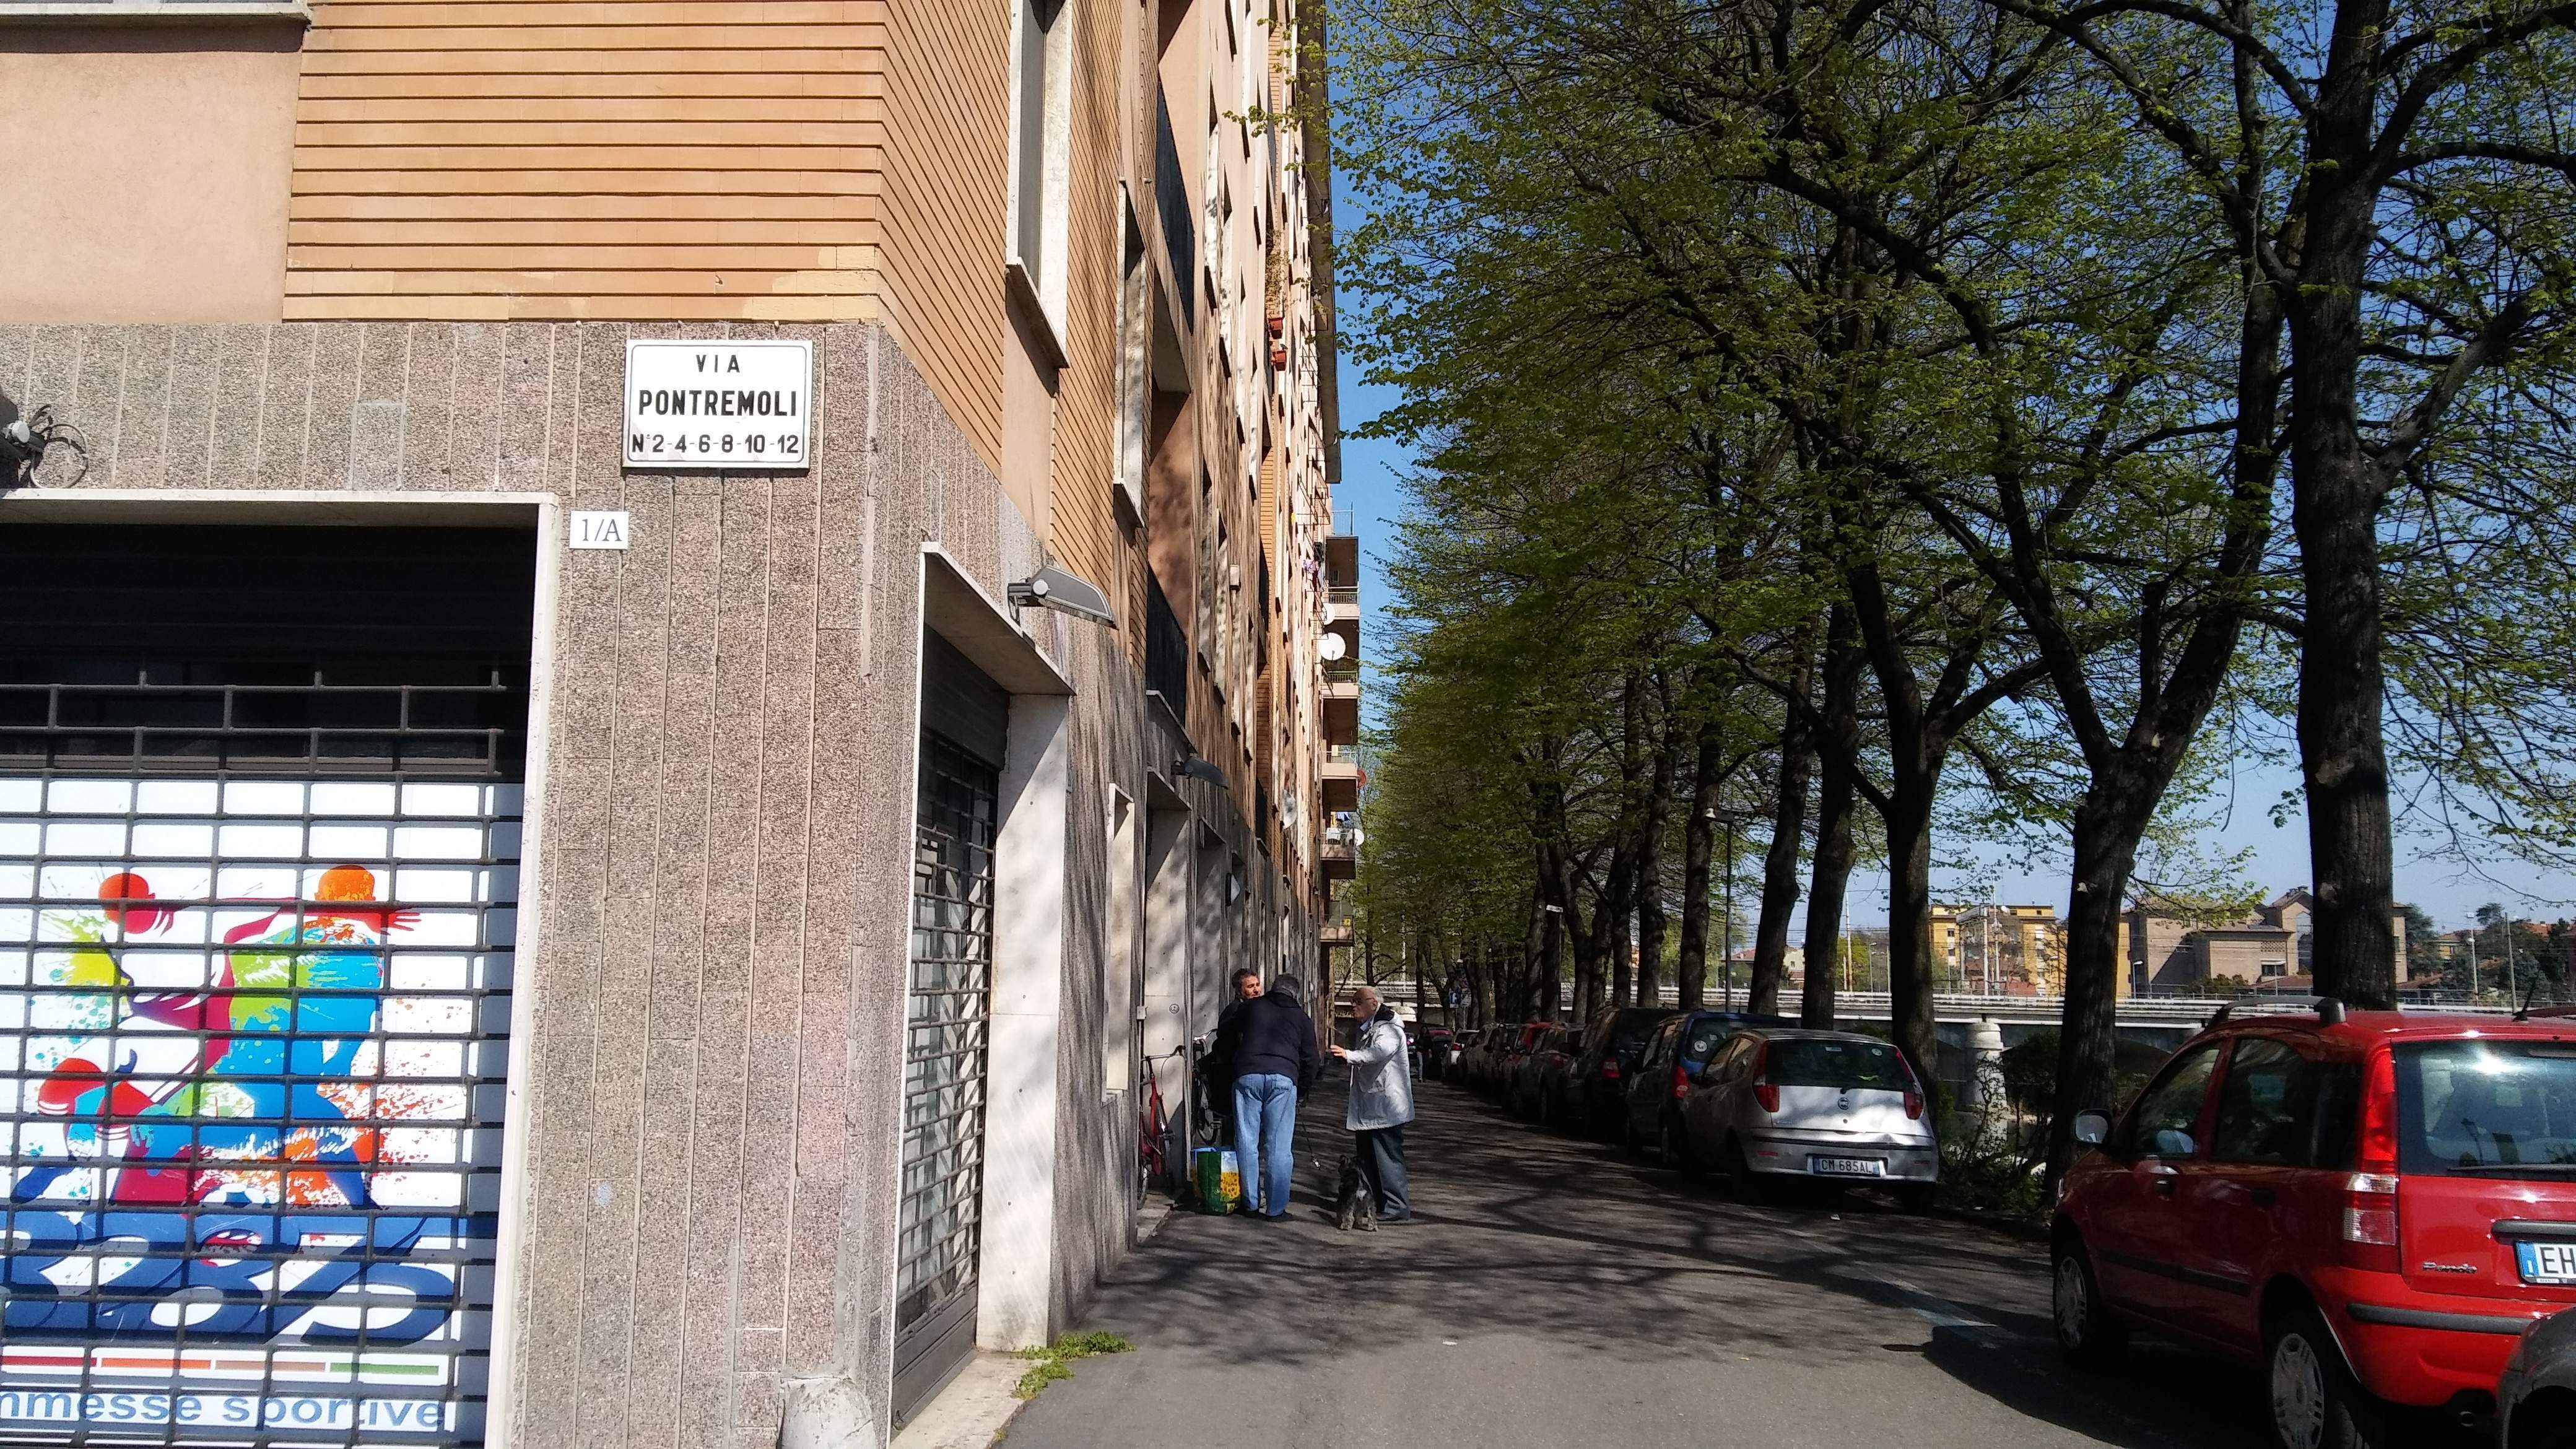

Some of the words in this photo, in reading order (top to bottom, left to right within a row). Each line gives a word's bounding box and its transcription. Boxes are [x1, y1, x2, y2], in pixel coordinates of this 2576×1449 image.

[695, 354, 741, 372] VIA
[638, 389, 796, 416] PONTREMOLI
[582, 519, 622, 542] 1/A
[2539, 1246, 2576, 1274] EH
[222, 1396, 445, 1432] sportive
